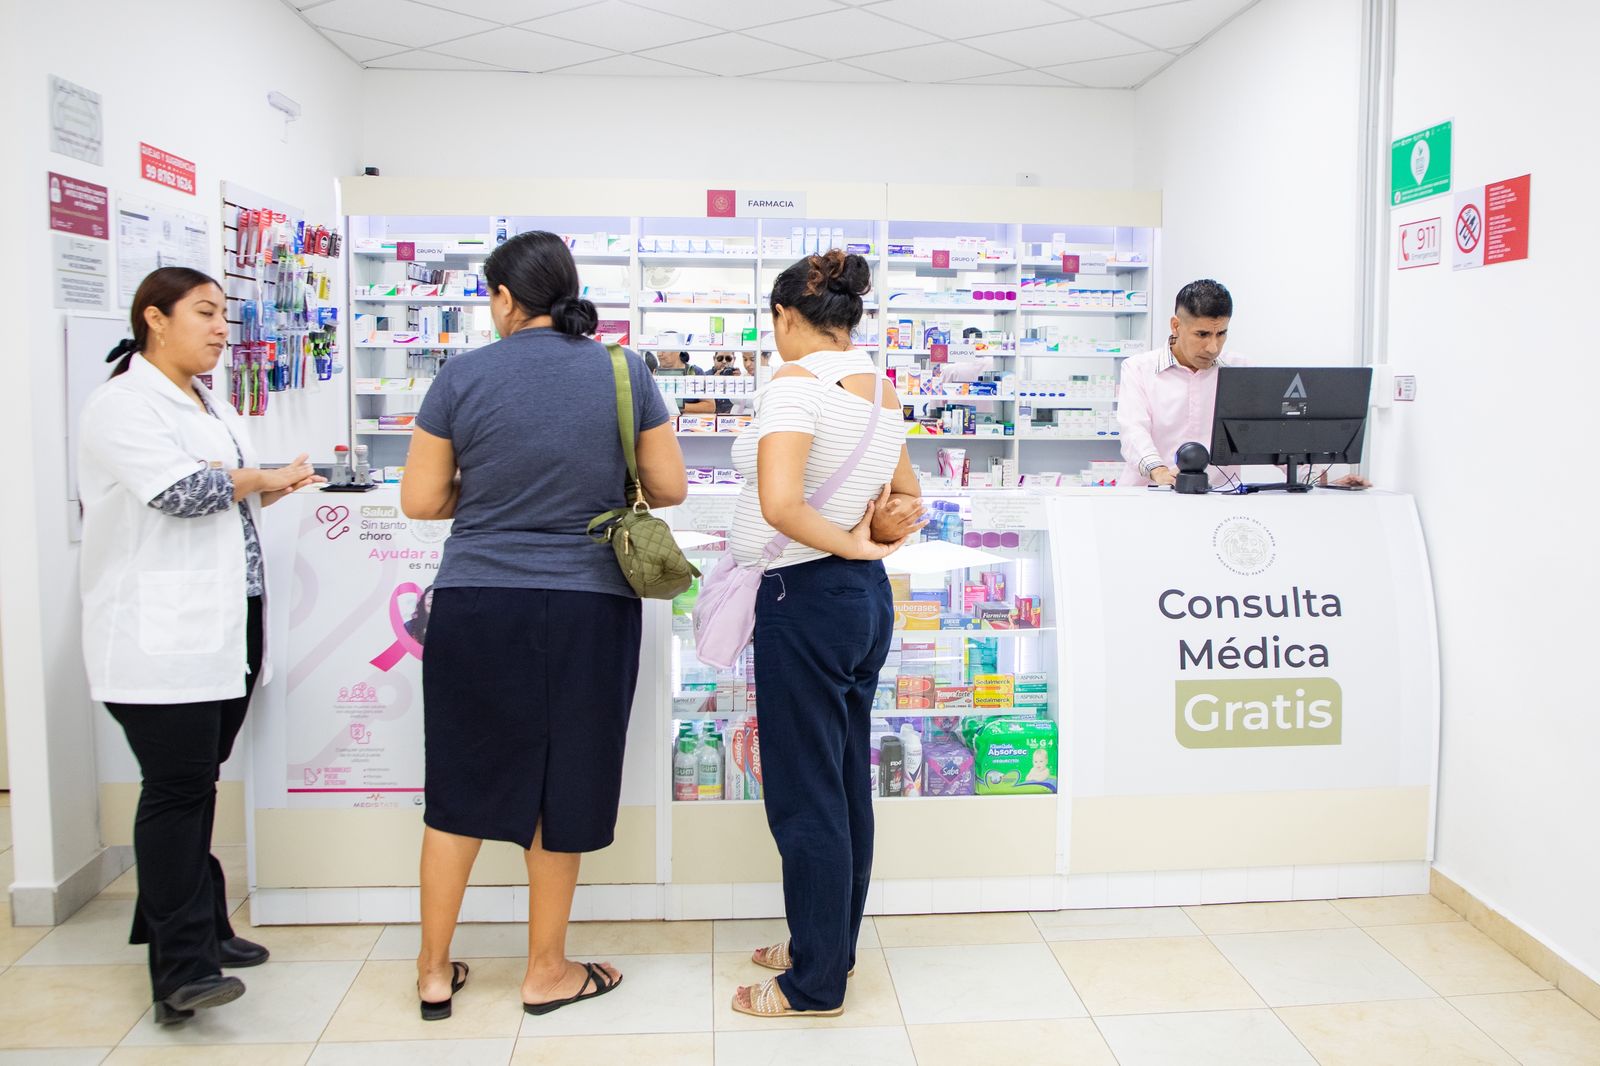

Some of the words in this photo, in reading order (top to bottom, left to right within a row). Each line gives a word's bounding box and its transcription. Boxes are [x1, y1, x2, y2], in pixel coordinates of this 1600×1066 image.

[145, 164, 157, 179] 99
[748, 200, 794, 208] FARMACIA
[1417, 226, 1436, 250] 911
[362, 507, 395, 518] Salud
[360, 520, 378, 530] Sin
[380, 521, 407, 530] tanto
[359, 531, 392, 541] choro
[368, 548, 425, 562] Ayudar
[430, 551, 439, 559] a
[1158, 586, 1342, 620] Consulta
[1179, 635, 1330, 670] Médica
[1184, 688, 1333, 732] Gratis
[736, 731, 744, 764] Colgate
[752, 728, 761, 774] Colgate
[988, 748, 1028, 756] Absorsec
[943, 766, 959, 776] Saba
